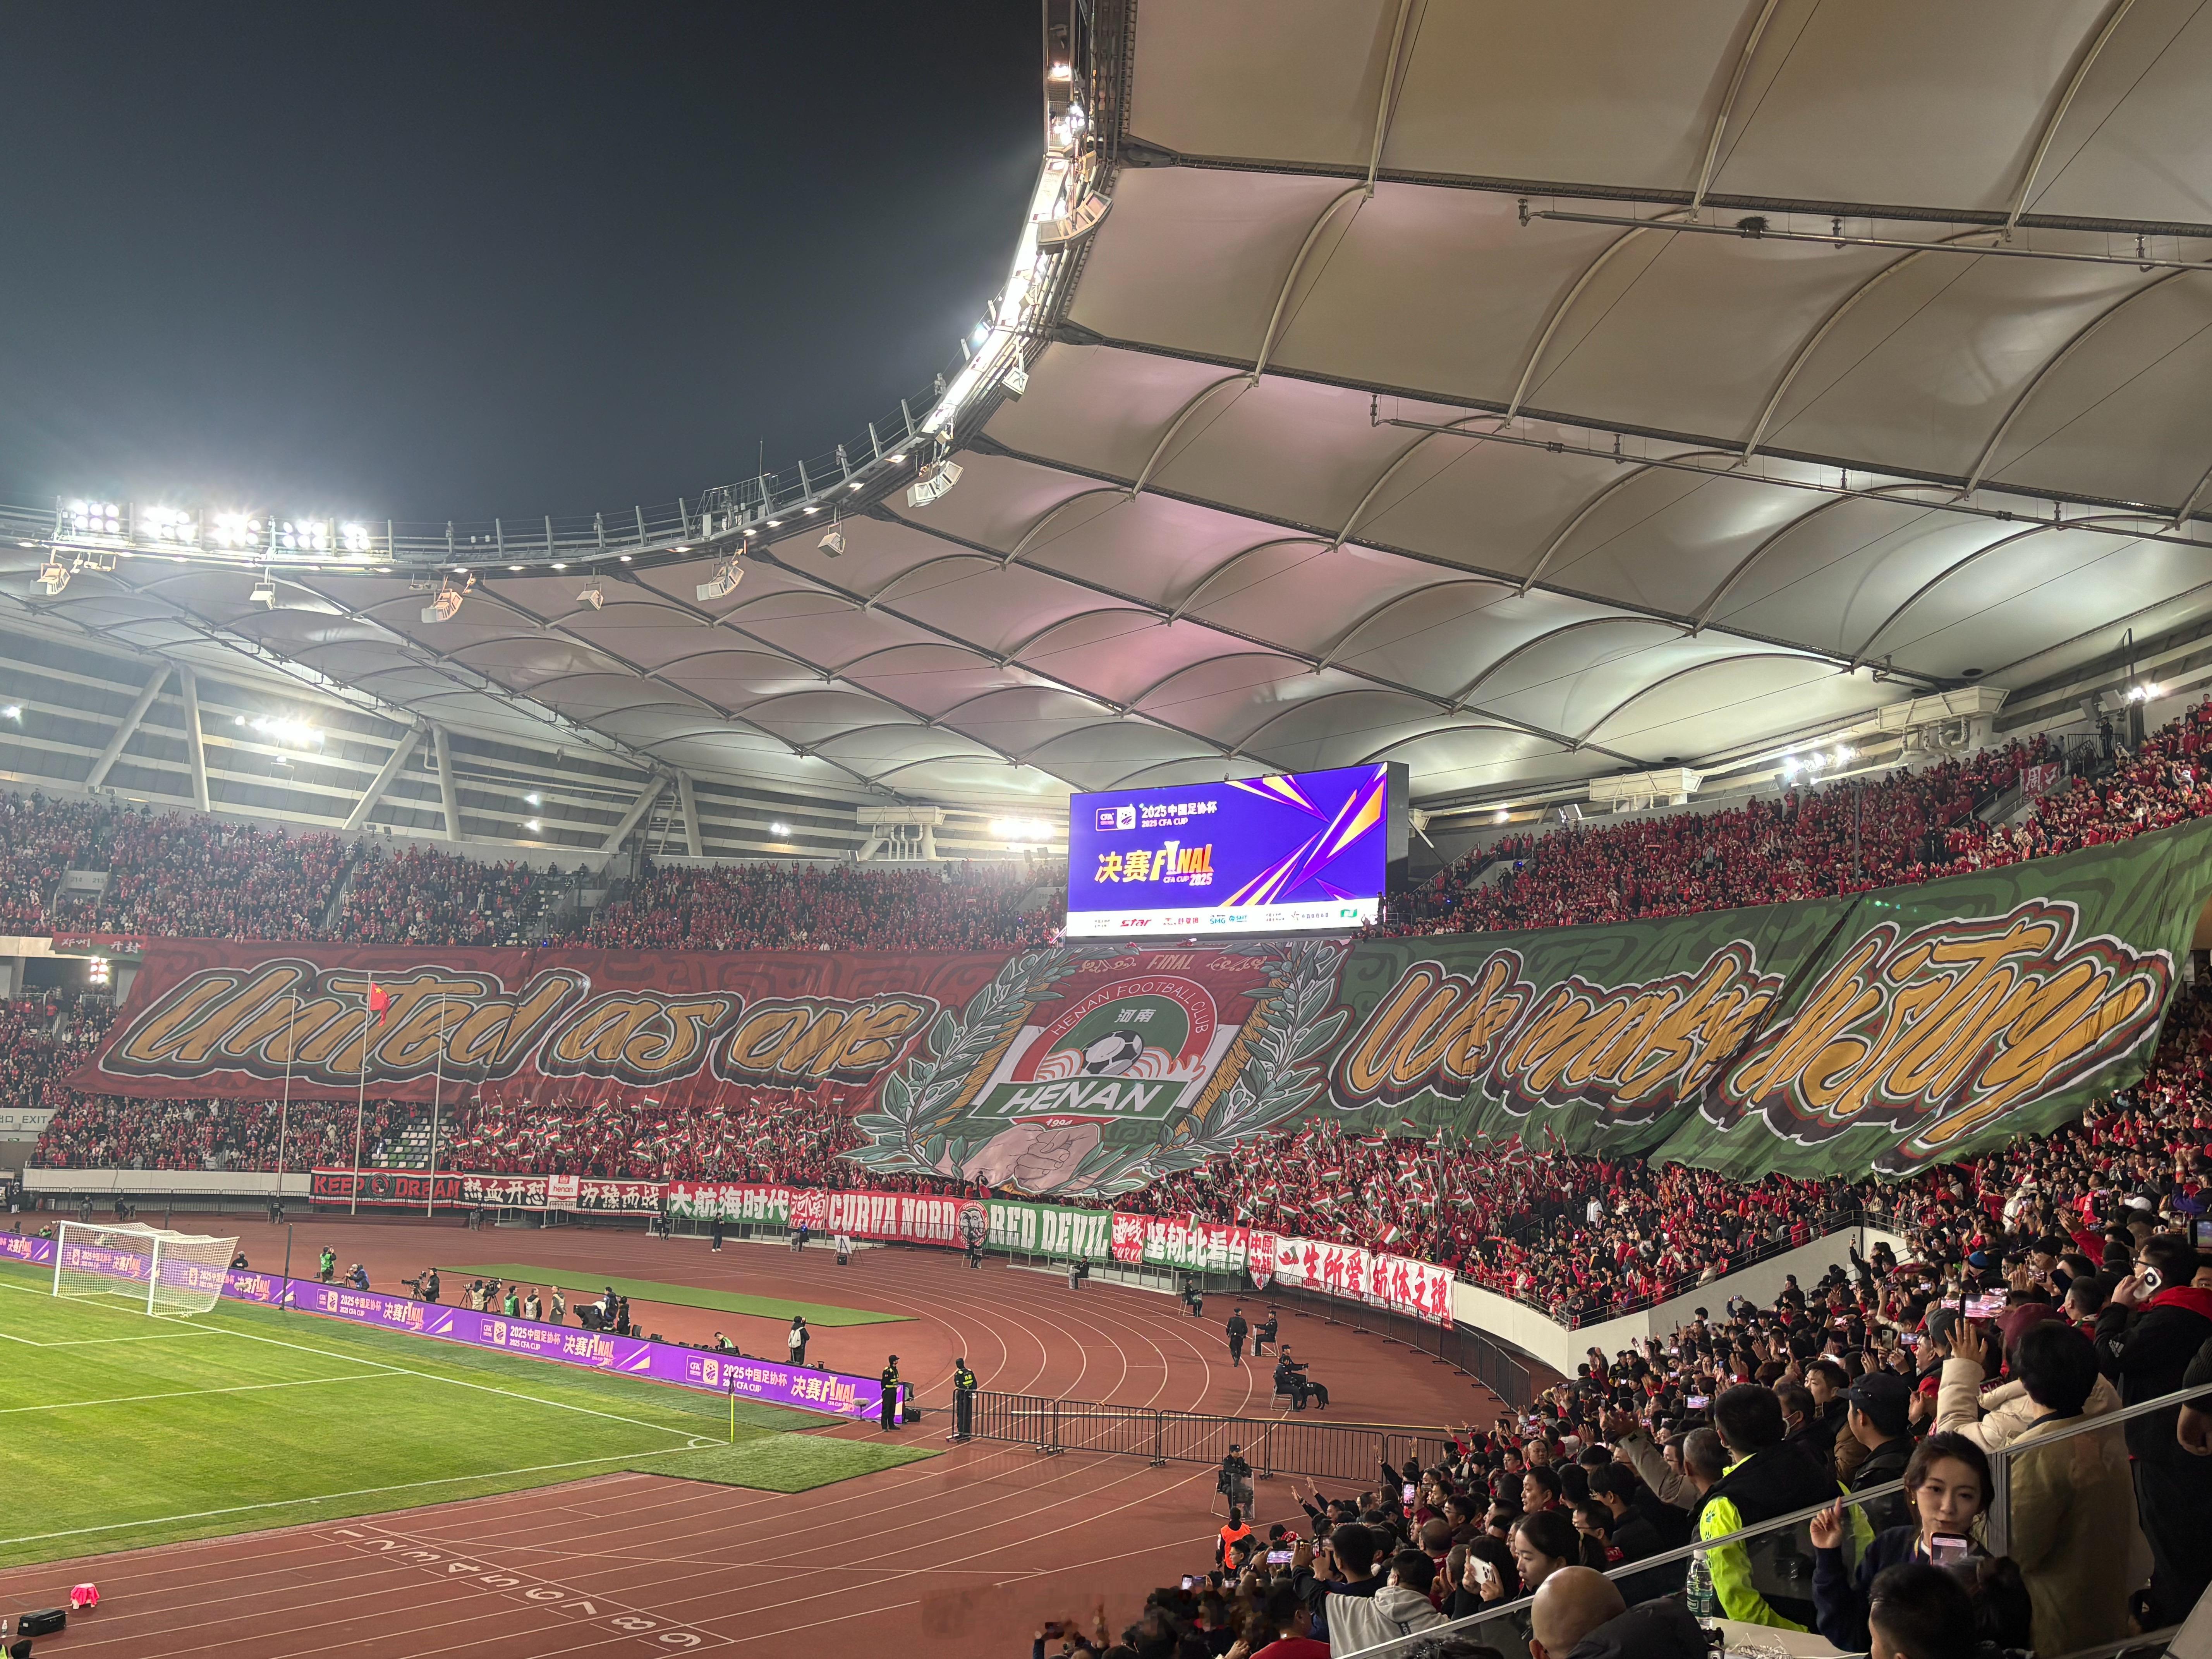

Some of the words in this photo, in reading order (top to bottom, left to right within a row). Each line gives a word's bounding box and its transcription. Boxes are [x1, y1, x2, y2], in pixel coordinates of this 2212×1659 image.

[1142, 801, 1217, 818] 2025中国足协杯
[1142, 819, 1157, 828] 2025
[1189, 873, 1212, 886] 2025
[110, 940, 141, 954] 开封
[1146, 955, 1195, 970] FINAL
[1051, 991, 1110, 1036] HENAN
[1117, 982, 1195, 1004] FOOTBALL
[1191, 1001, 1209, 1034] CLUB
[1114, 1008, 1156, 1023] 河南
[996, 1081, 1164, 1114] HENAN
[1046, 1118, 1073, 1127] 1994
[313, 1175, 365, 1195] KEEP
[395, 1179, 460, 1199] DREAM
[581, 1183, 659, 1211] 为豫而战
[670, 1184, 789, 1221] 大航海时代
[791, 1190, 826, 1218] 河南
[829, 1194, 897, 1235] CURVA
[901, 1197, 955, 1240] NORD
[989, 1204, 1037, 1249] RED
[1041, 1209, 1107, 1257] DEVIL
[1250, 1233, 1273, 1254] 中原
[1112, 1246, 1142, 1261] CURVA
[340, 1295, 381, 1312] 2025中国足协杯
[510, 1326, 561, 1345] 2025中国足协杯
[509, 1339, 520, 1347] 2025
[521, 1341, 530, 1349] CFA
[531, 1342, 541, 1351] CUP
[690, 1362, 700, 1371] CFA
[723, 1364, 787, 1387] 2025中国足协杯
[737, 1382, 748, 1391] CFA
[749, 1384, 762, 1393] CUP
[333, 1530, 365, 1538] 1
[365, 1540, 407, 1551] 2
[400, 1551, 441, 1562] 3
[448, 1562, 481, 1573] 4
[480, 1575, 520, 1587] 5
[525, 1588, 565, 1600] 6
[561, 1601, 597, 1615] 7
[611, 1616, 657, 1630] 8
[659, 1632, 702, 1647] 9
